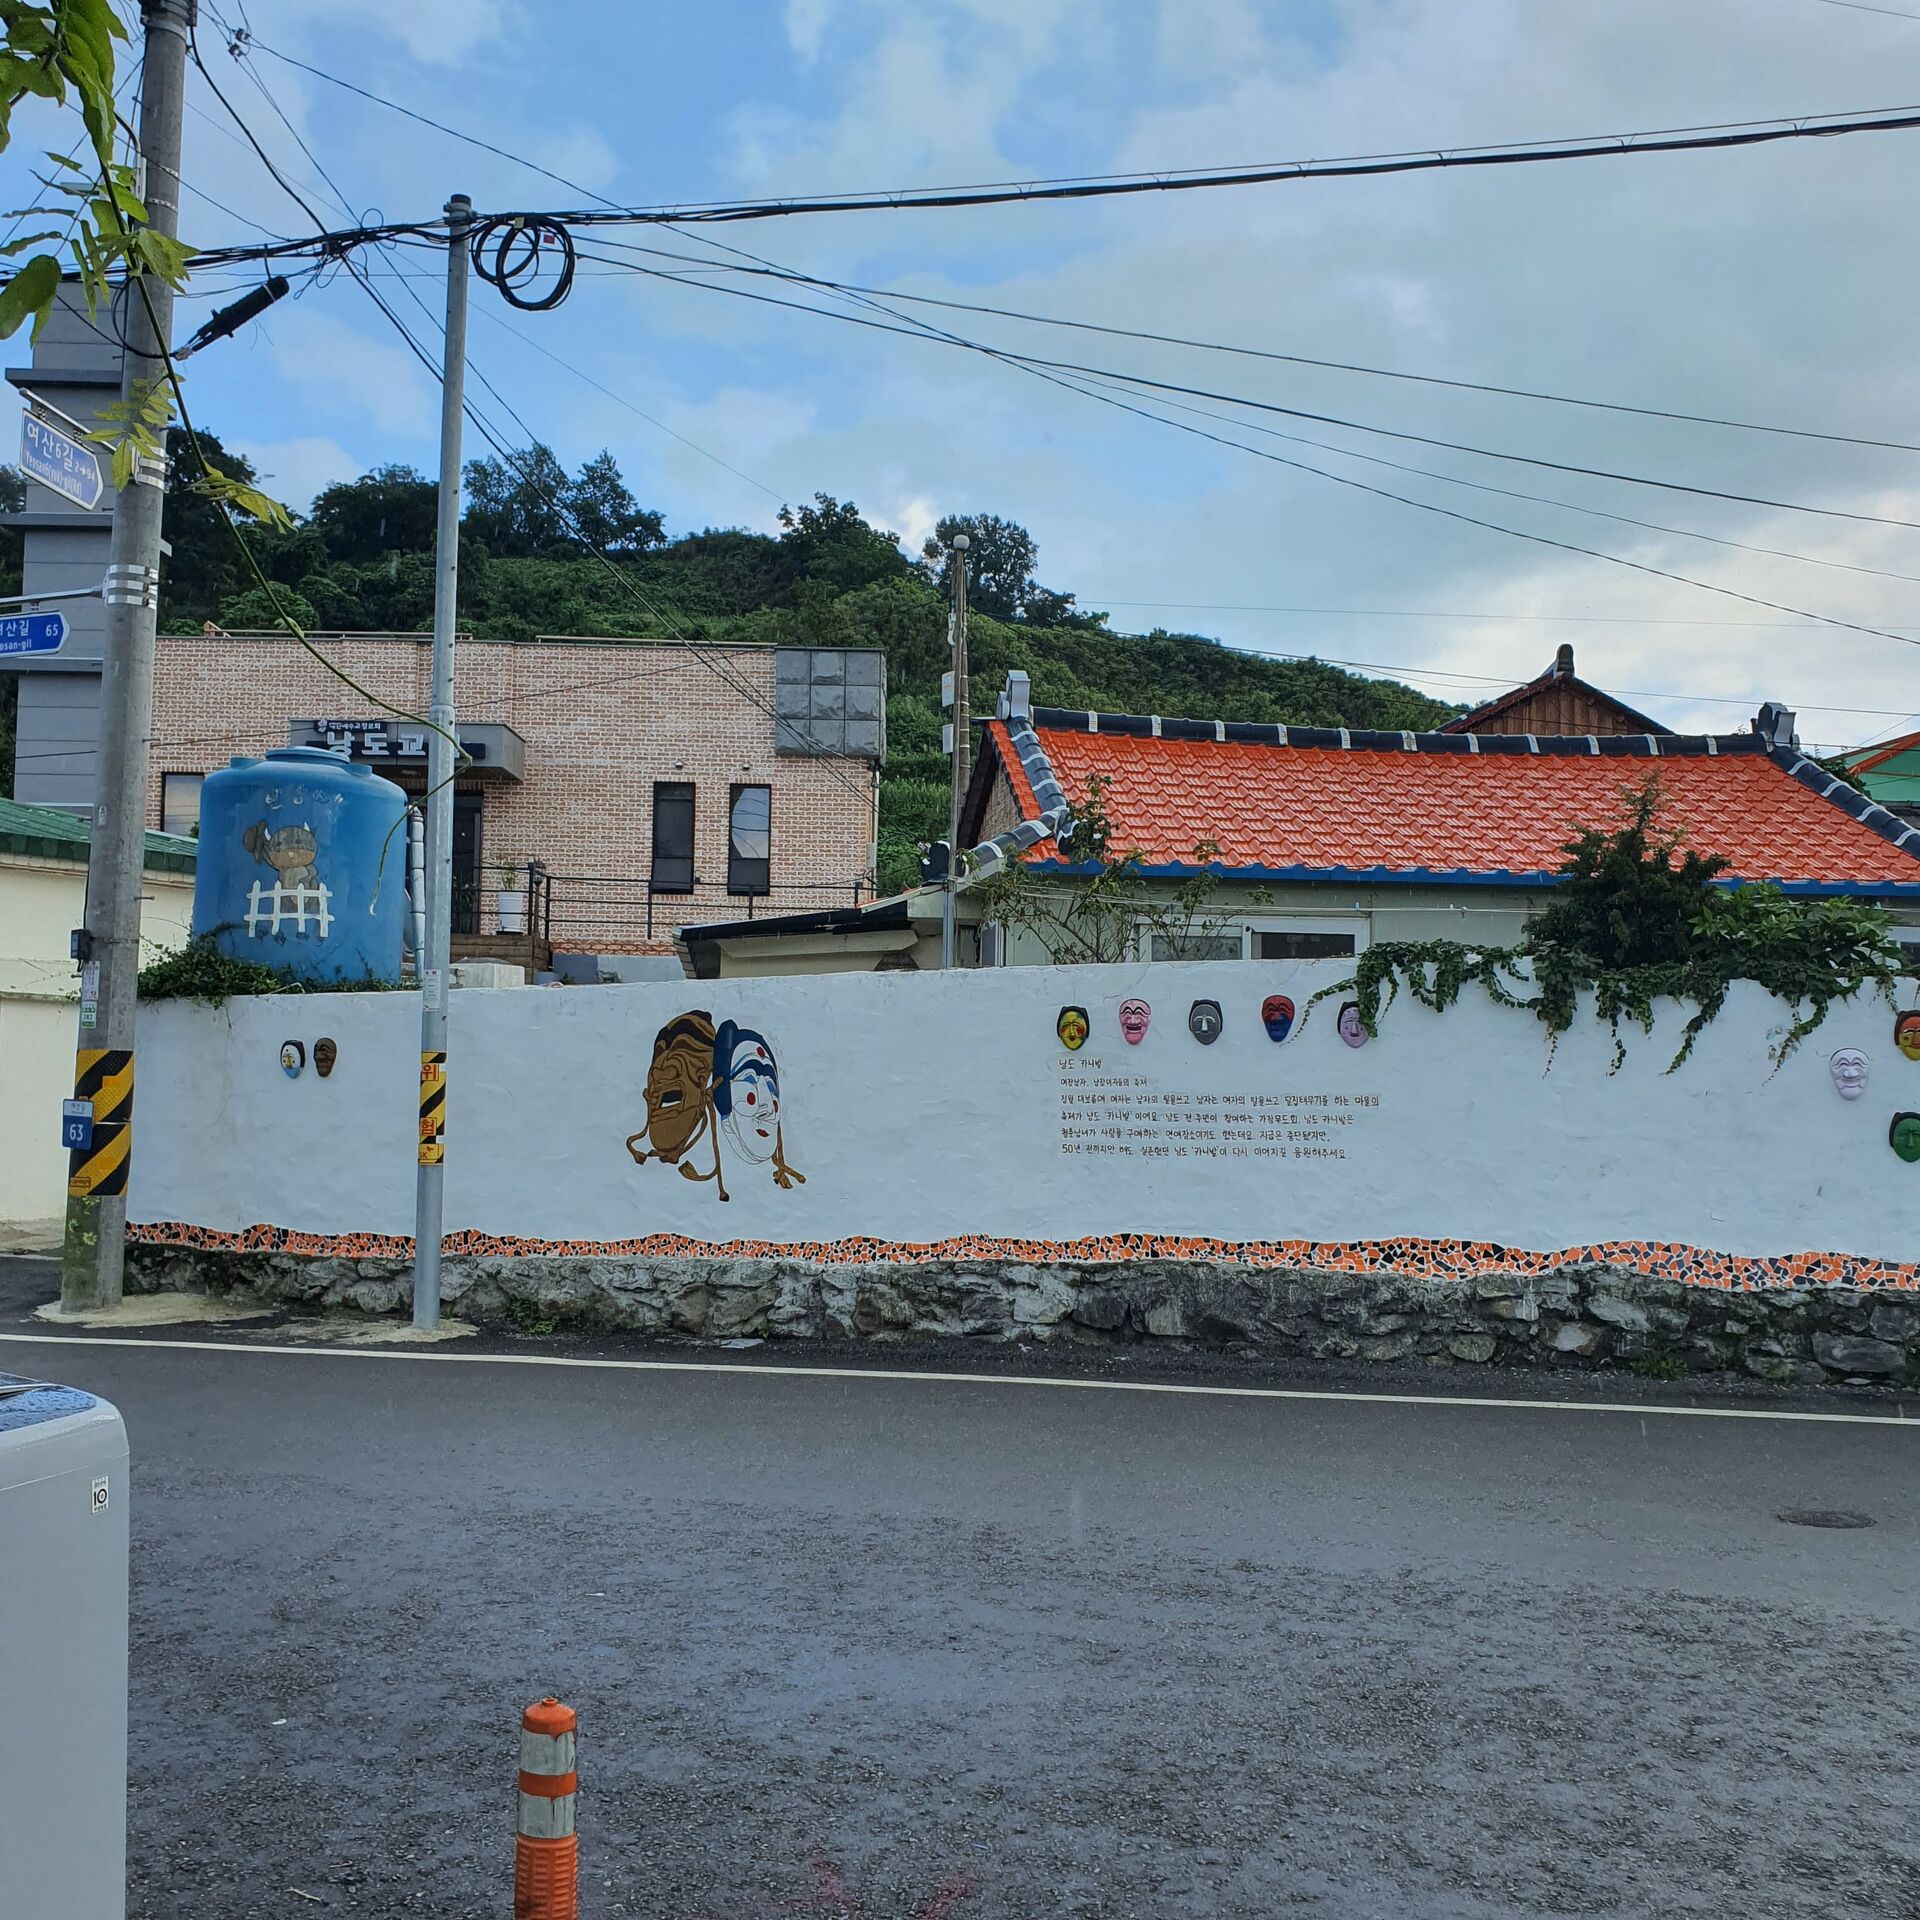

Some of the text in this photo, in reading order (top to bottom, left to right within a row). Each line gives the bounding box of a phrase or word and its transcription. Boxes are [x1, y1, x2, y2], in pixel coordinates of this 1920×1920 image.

[27, 422, 73, 472] 여산6길
[45, 624, 59, 637] 65
[327, 731, 461, 758] 낭도교
[1059, 1059, 1074, 1069] 낭도
[1134, 1077, 1147, 1087] 축제
[1078, 1094, 1105, 1104] 대보름에
[1111, 1095, 1131, 1104] 여자는
[1136, 1095, 1158, 1104] 남자의
[1196, 1095, 1218, 1104] 남자는
[1223, 1096, 1245, 1104] 여자의
[1334, 1096, 1349, 1106] 하는
[1355, 1096, 1379, 1106] 마을의
[1061, 1111, 1082, 1121] 축제가
[1087, 1112, 1100, 1121] 낭도
[1166, 1113, 1179, 1122] 낭도
[1224, 1114, 1254, 1123] 참여하는
[1304, 1115, 1318, 1124] 낭도
[1322, 1115, 1354, 1125] 카니발은
[70, 1124, 83, 1141] 63
[1101, 1128, 1122, 1138] 사랑을
[1259, 1130, 1282, 1141] 지금은
[1063, 1144, 1081, 1154] 50년
[1085, 1144, 1115, 1154] 전까지만
[1119, 1146, 1133, 1155] 해도
[1174, 1146, 1188, 1156] 낭도
[1232, 1147, 1247, 1157] 다시
[1254, 1147, 1286, 1157] 이어지길
